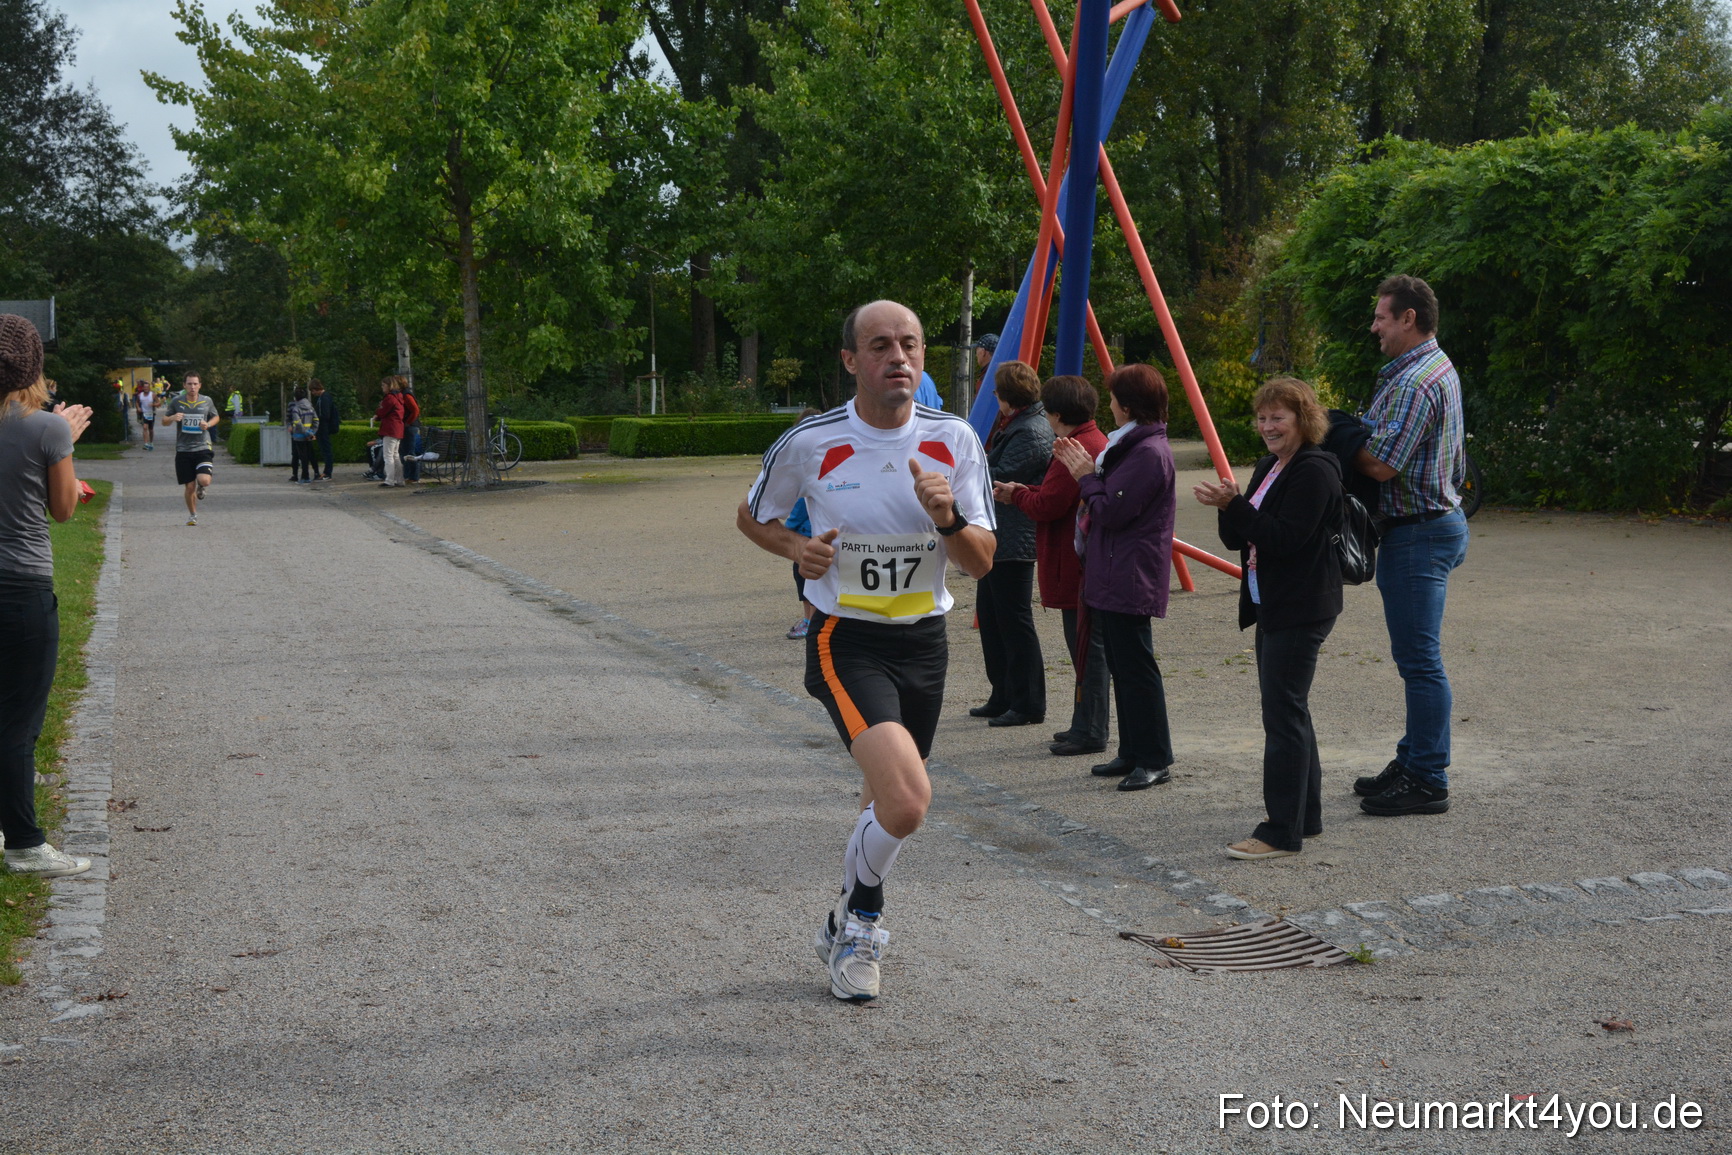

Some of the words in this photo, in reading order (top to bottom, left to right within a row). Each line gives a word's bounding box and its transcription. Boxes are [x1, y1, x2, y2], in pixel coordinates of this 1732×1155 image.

[841, 541, 874, 553] PARTL
[877, 543, 924, 553] Neumarkt
[860, 557, 922, 592] 617
